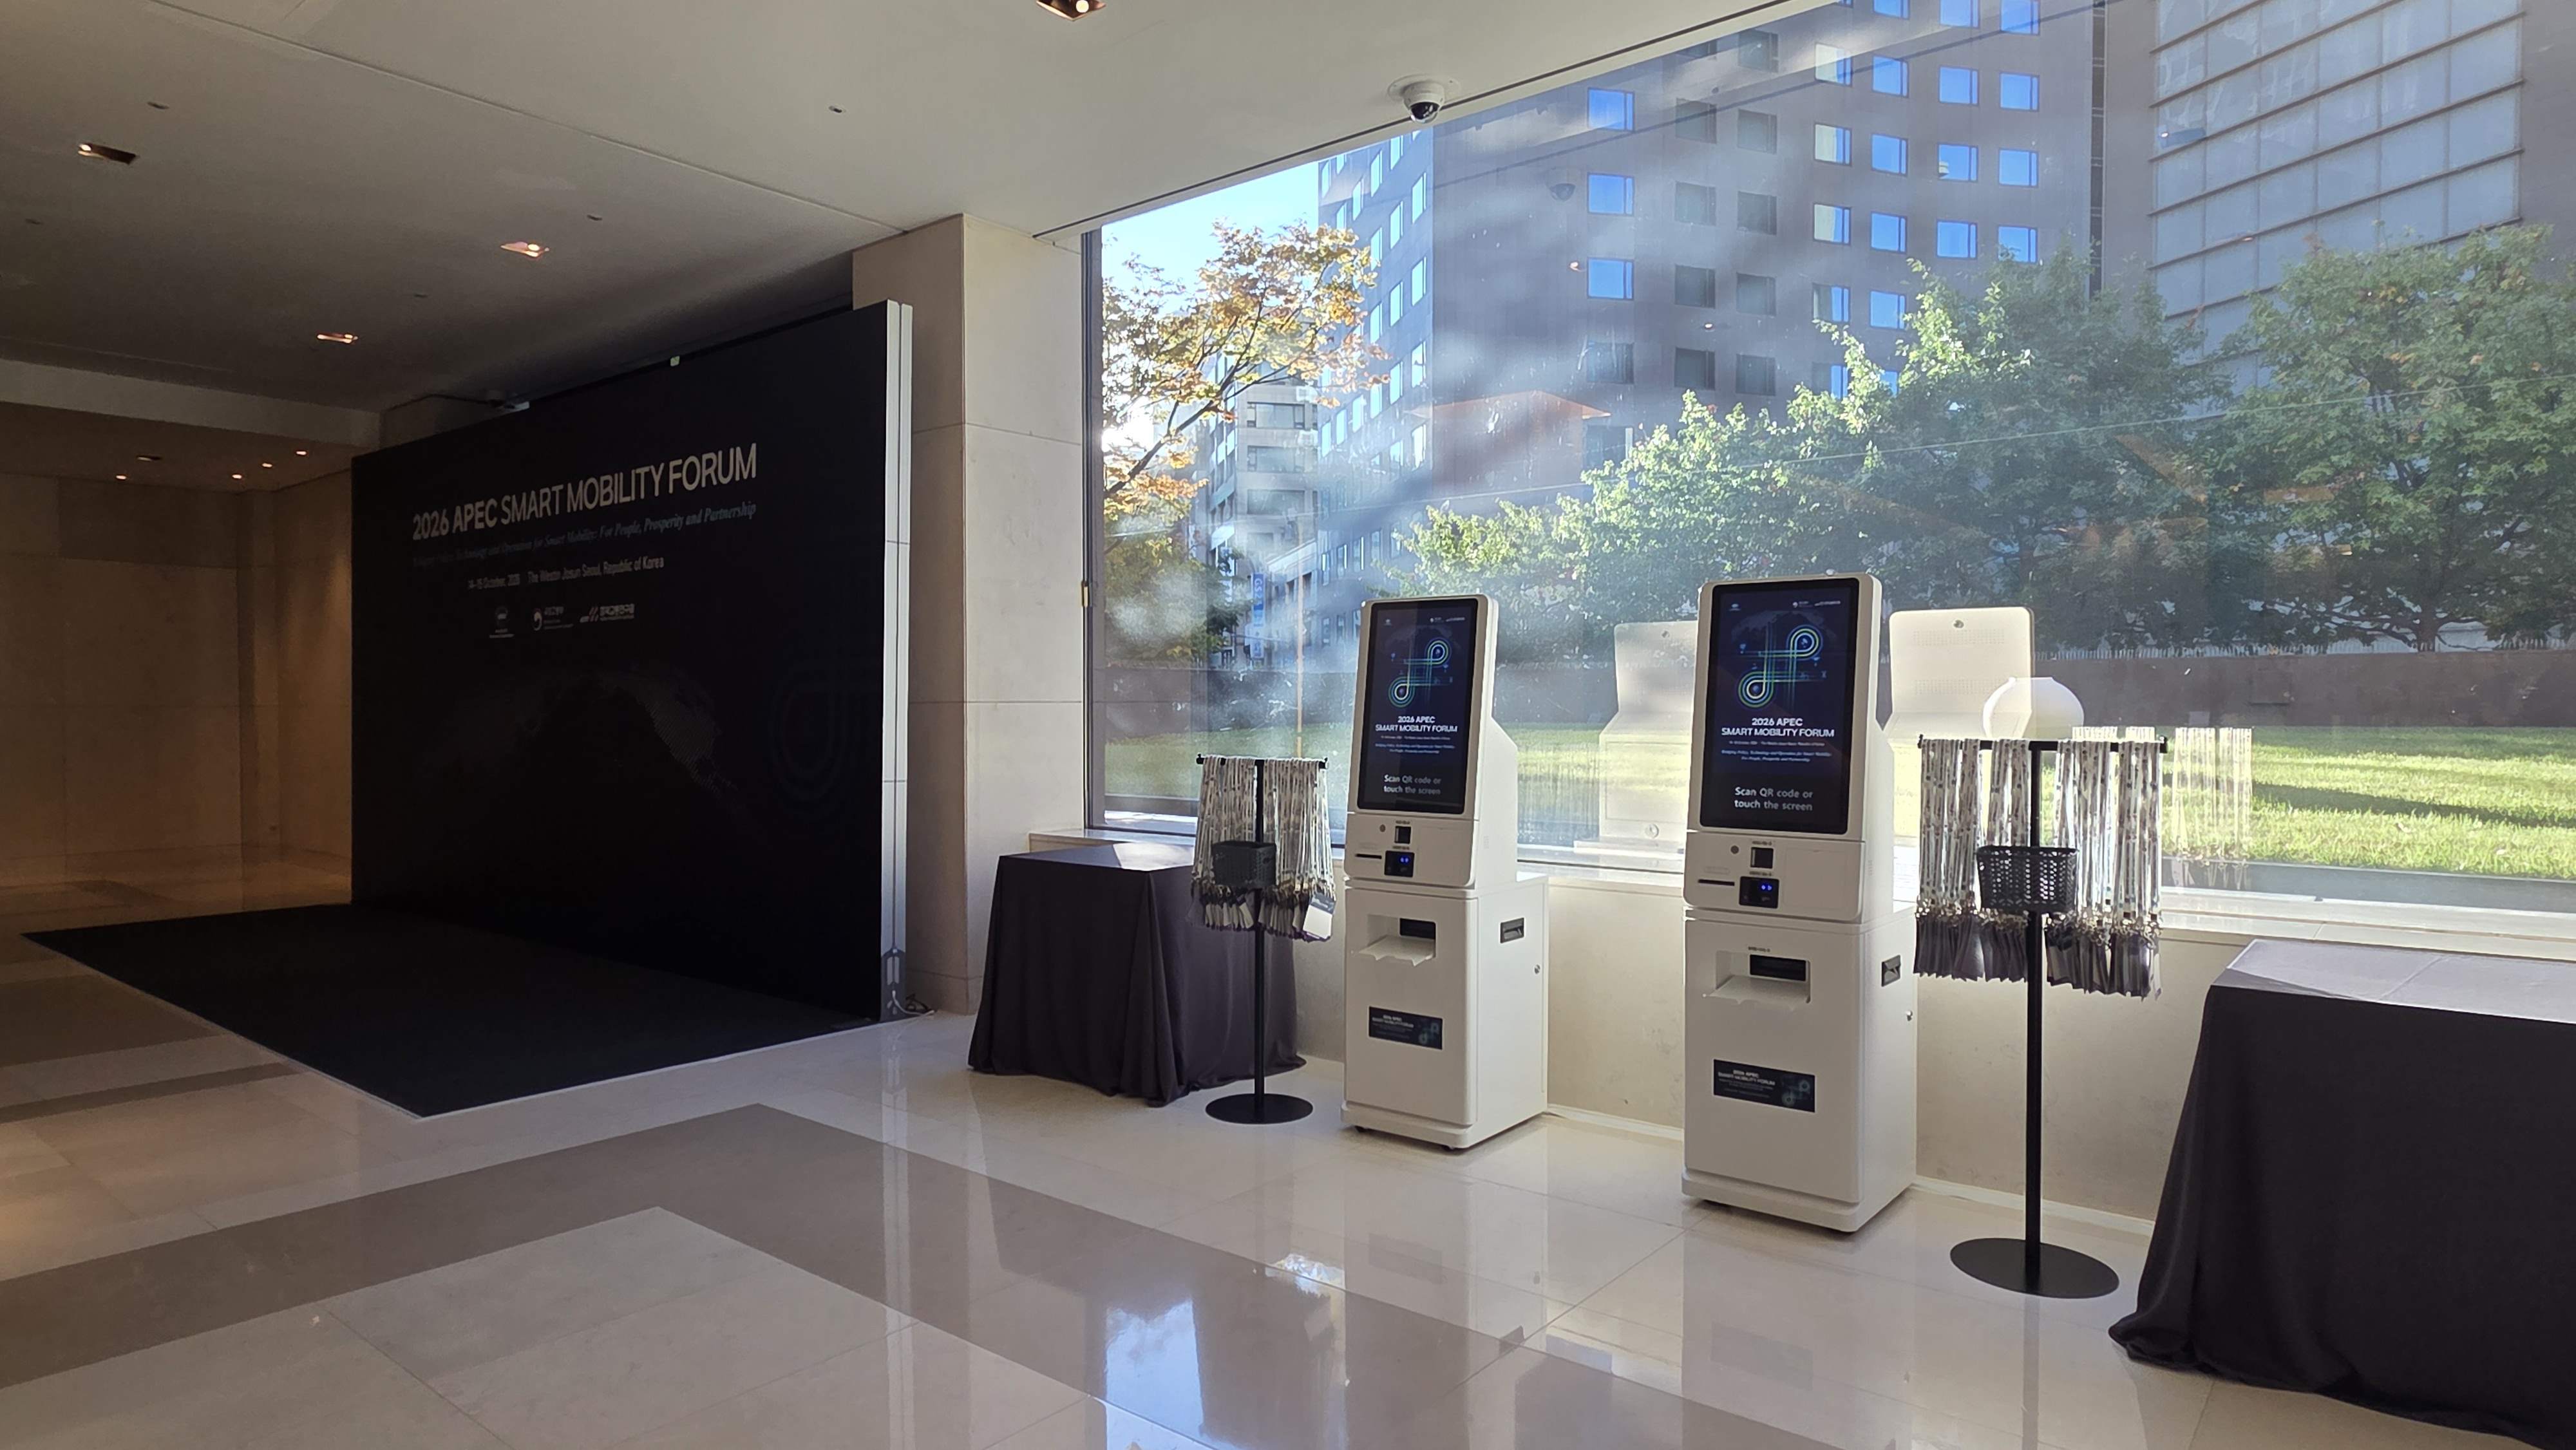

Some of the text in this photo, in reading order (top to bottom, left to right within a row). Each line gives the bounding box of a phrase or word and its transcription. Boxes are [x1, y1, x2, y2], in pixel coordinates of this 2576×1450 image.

[412, 443, 757, 540] 2026 APEC SMART MOBILITY FORUM
[614, 520, 641, 538] People,
[644, 514, 684, 532] Prosperity
[685, 509, 702, 525] and
[704, 501, 757, 522] Partnership
[603, 560, 632, 576] Republic
[634, 558, 641, 570] of
[643, 556, 665, 570] Korea
[1752, 718, 1803, 726] 2026 APEC
[1721, 728, 1835, 737] SMART MOBILITY FORUM
[1402, 775, 1413, 784] QR
[1735, 787, 1757, 796] Scan
[1759, 787, 1774, 797] QR
[1777, 789, 1800, 798] code
[1734, 800, 1813, 811] touch the screen
